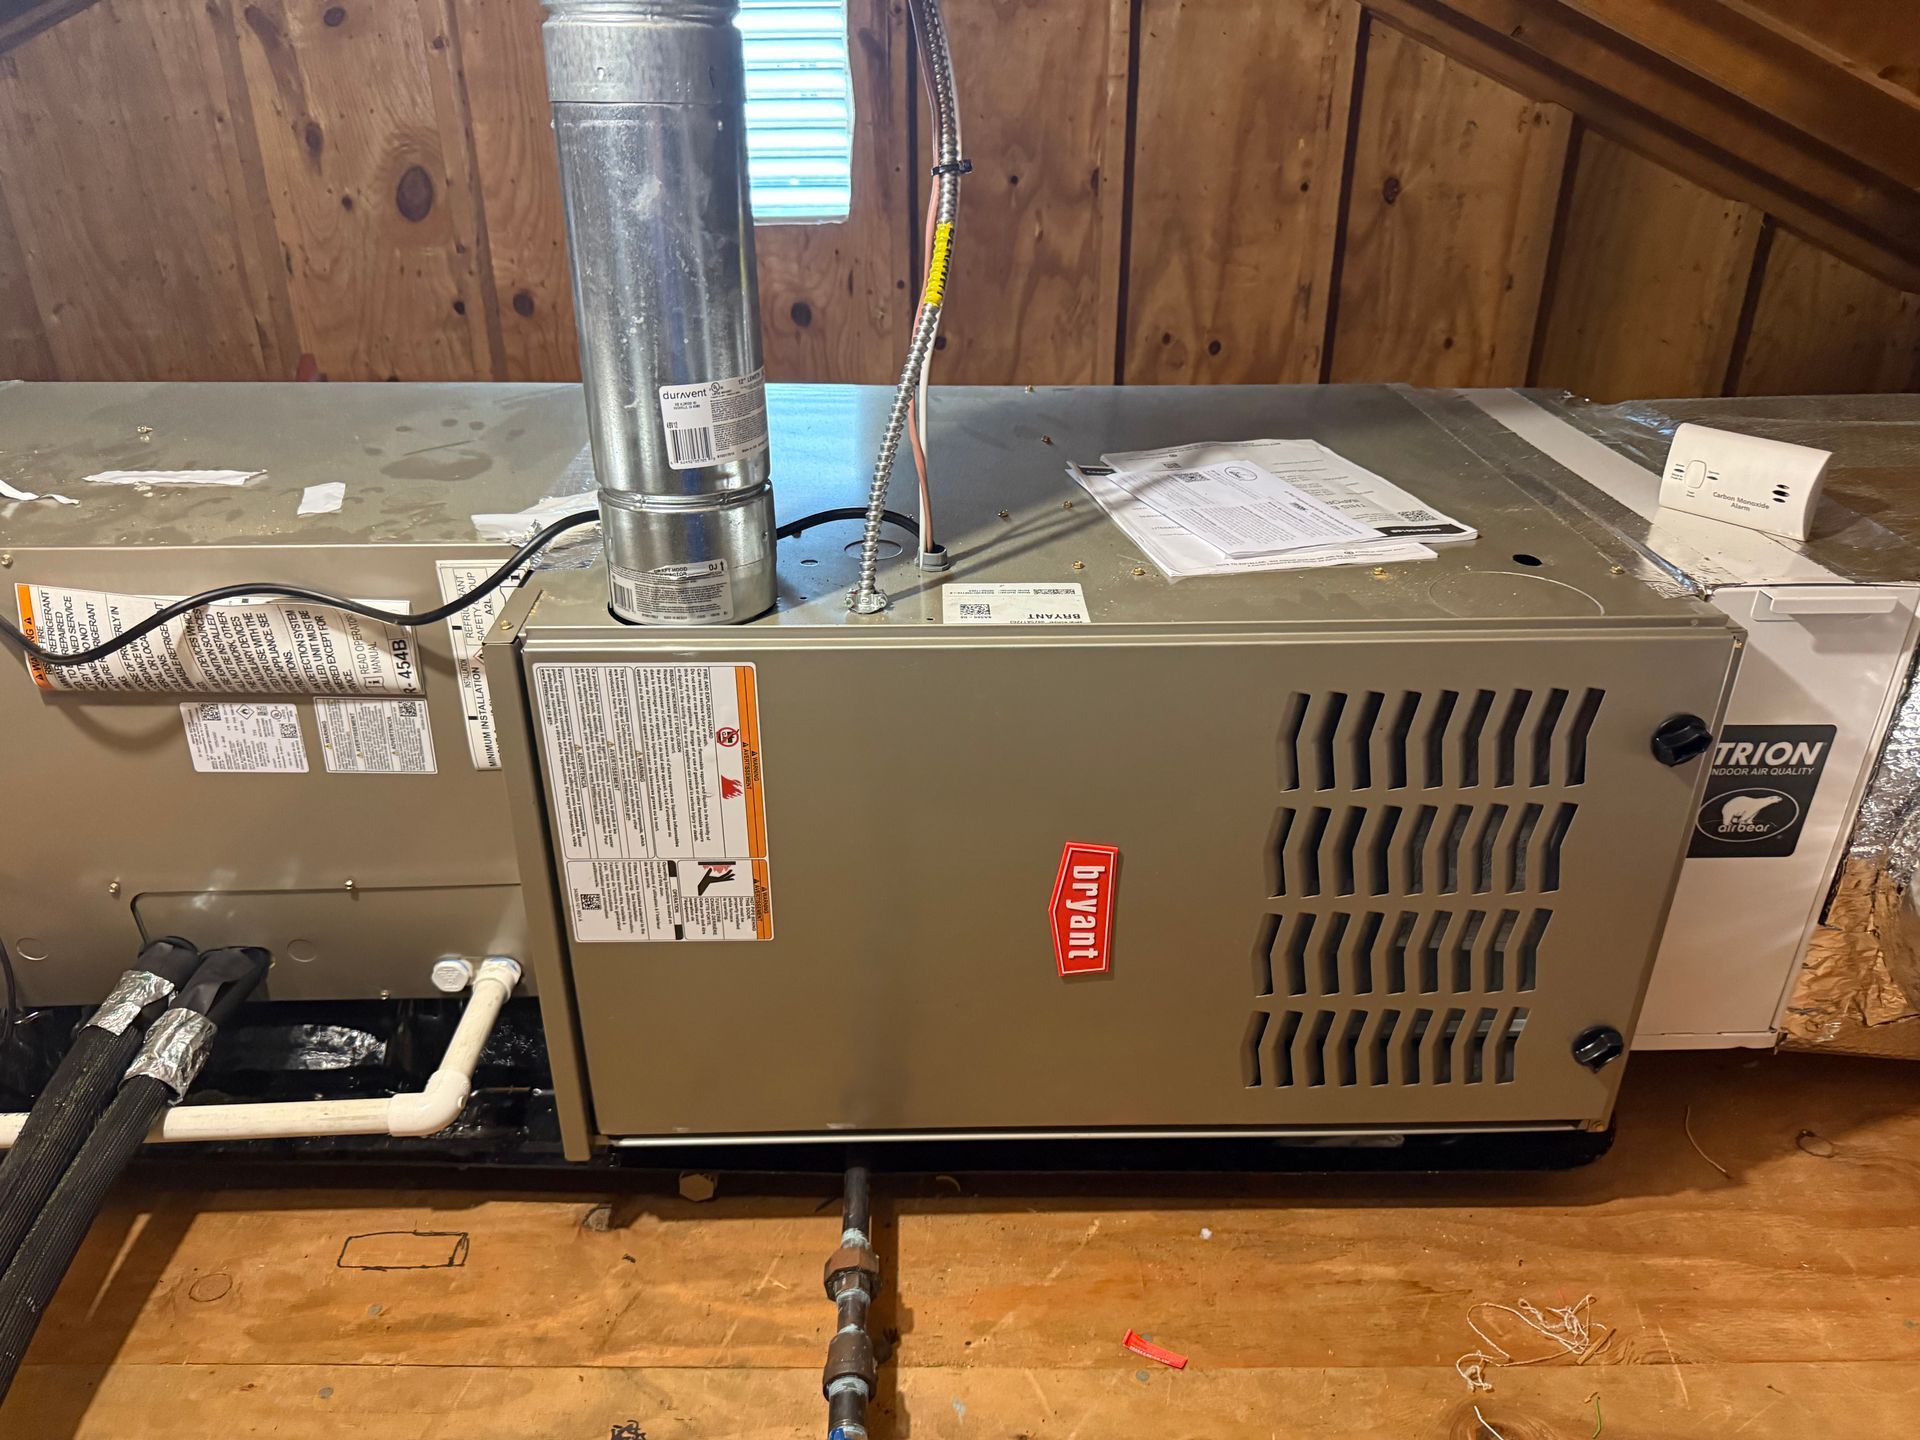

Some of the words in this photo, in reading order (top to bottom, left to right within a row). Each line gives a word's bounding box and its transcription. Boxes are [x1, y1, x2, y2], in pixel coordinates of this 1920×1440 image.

[1712, 491, 1736, 502] Carbon
[1736, 497, 1770, 510] Monoxide
[1730, 502, 1750, 512] Alarm
[64, 596, 77, 634] SERVICE
[111, 606, 119, 615] IN
[243, 613, 256, 626] THE
[298, 610, 310, 619] BE
[485, 598, 494, 615] A2L
[41, 590, 58, 653] REFRIGERANT
[55, 612, 70, 655] REPAIRED
[78, 622, 88, 641] NOT
[194, 609, 211, 647] SOURCES
[217, 612, 233, 638] OTHER
[231, 616, 250, 648] DEVICES
[256, 613, 269, 628] SEE
[285, 610, 303, 640] SYSTEM
[303, 619, 317, 641] MUST
[315, 615, 326, 630] FOR
[473, 607, 486, 641] SAFETY
[36, 626, 45, 644] FIRE
[206, 614, 227, 654] INSTALLED
[249, 628, 263, 648] WITH
[190, 638, 209, 667] DEVICES
[223, 655, 232, 664] BE
[255, 649, 268, 664] USE
[263, 628, 284, 672] APPLIANCE.
[296, 640, 315, 681] DETECTION
[310, 644, 322, 661] UNIT
[320, 632, 336, 663] EXCEPT
[370, 641, 382, 673] MANUAL
[392, 640, 412, 679] 454B
[67, 670, 78, 679] TO
[126, 662, 136, 672] OF
[147, 659, 158, 670] OR
[206, 649, 226, 676] IGNITION
[227, 666, 240, 679] NOT
[242, 648, 265, 681] AUXILIARY
[263, 665, 275, 677] FOR
[357, 654, 369, 674] READ
[459, 658, 471, 688] INSTALLATION
[472, 667, 489, 729] INSTALLATION
[321, 720, 330, 743] WARNING
[349, 712, 361, 751] AVERTISSEMENT
[385, 716, 396, 749] ADVERTENCIA
[483, 731, 498, 767] MINIMUM
[1713, 741, 1823, 766] TRION
[576, 752, 587, 788] ADVERTENCIA
[608, 748, 620, 790] AVERTISSEMENT
[636, 757, 645, 782] WARNING
[742, 749, 751, 789] AVERTISSEMENT
[1711, 768, 1749, 776] NDOOR
[1750, 768, 1768, 776] AIR
[1770, 767, 1814, 776] QUALITY
[1718, 822, 1770, 833] airbear
[753, 885, 762, 921] AVERTISSEMENT
[1066, 865, 1105, 959] bryant
